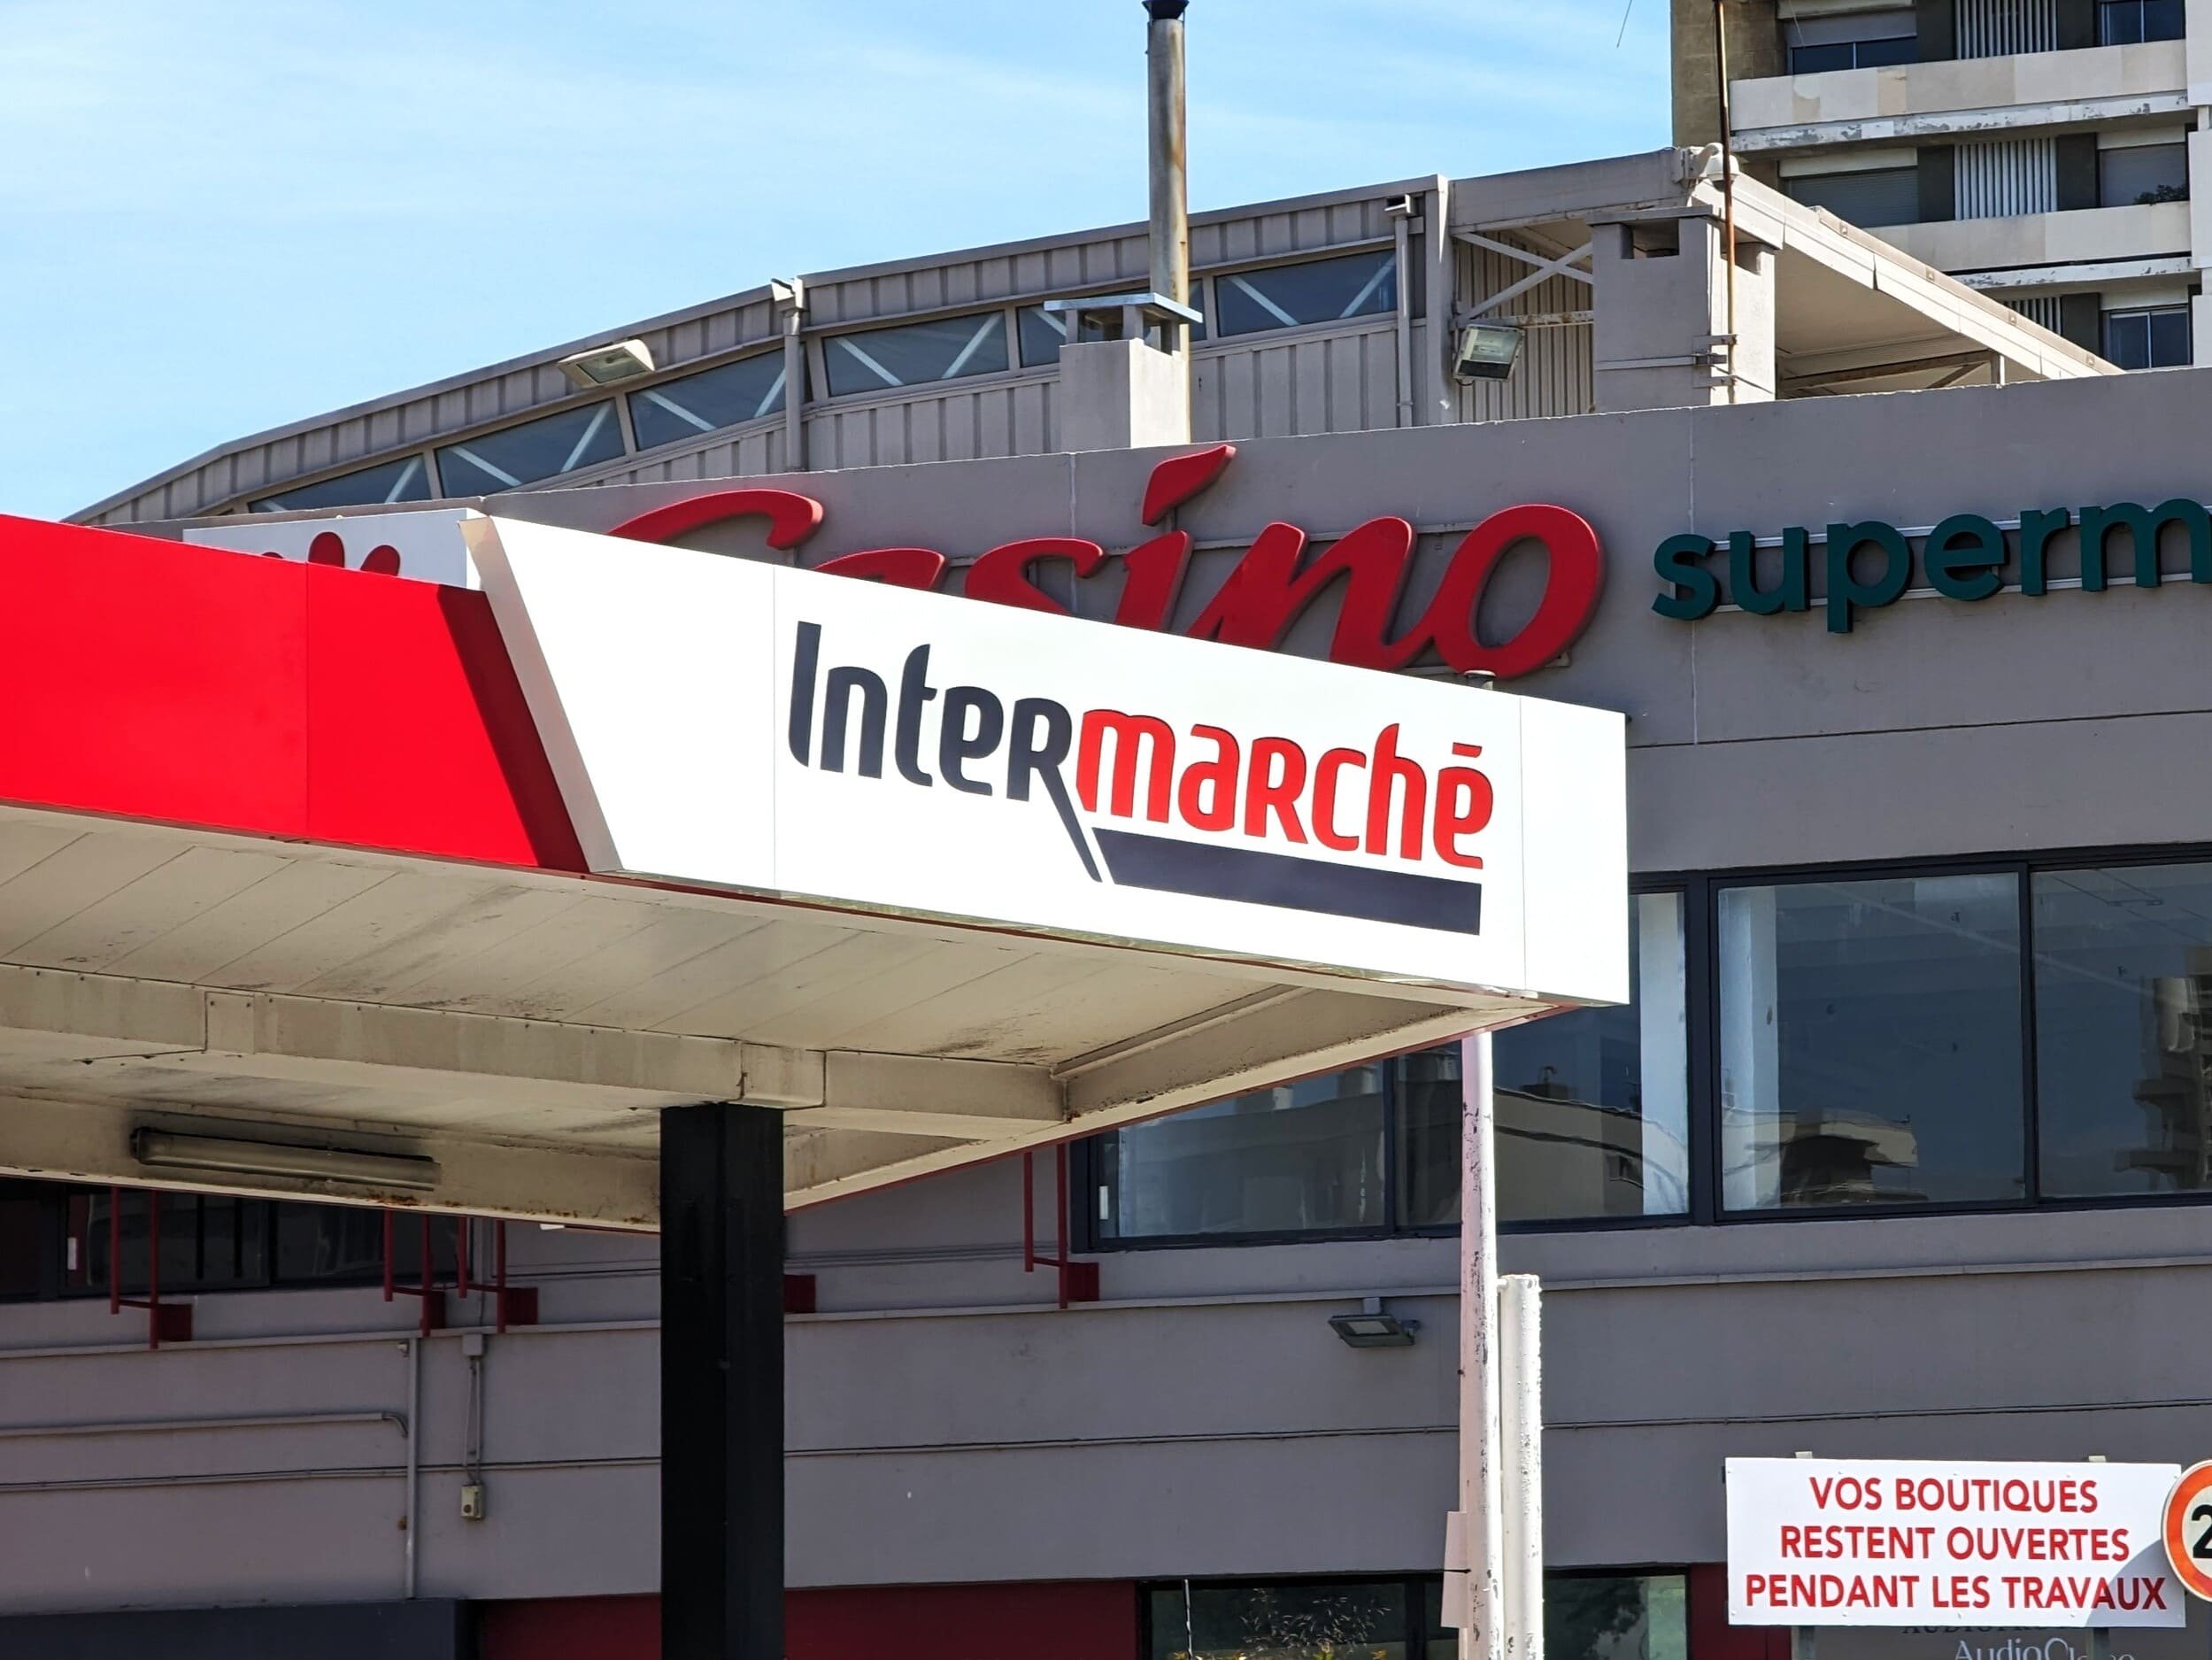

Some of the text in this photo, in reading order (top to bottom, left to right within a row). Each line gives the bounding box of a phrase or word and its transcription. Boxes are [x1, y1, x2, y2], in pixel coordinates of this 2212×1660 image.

[1809, 1477, 2098, 1513] VOS BOUTIQUES
[1781, 1525, 2130, 1562] RESTENT OUVERTES
[1746, 1574, 2167, 1610] PENDANT LES TRAVAUX
